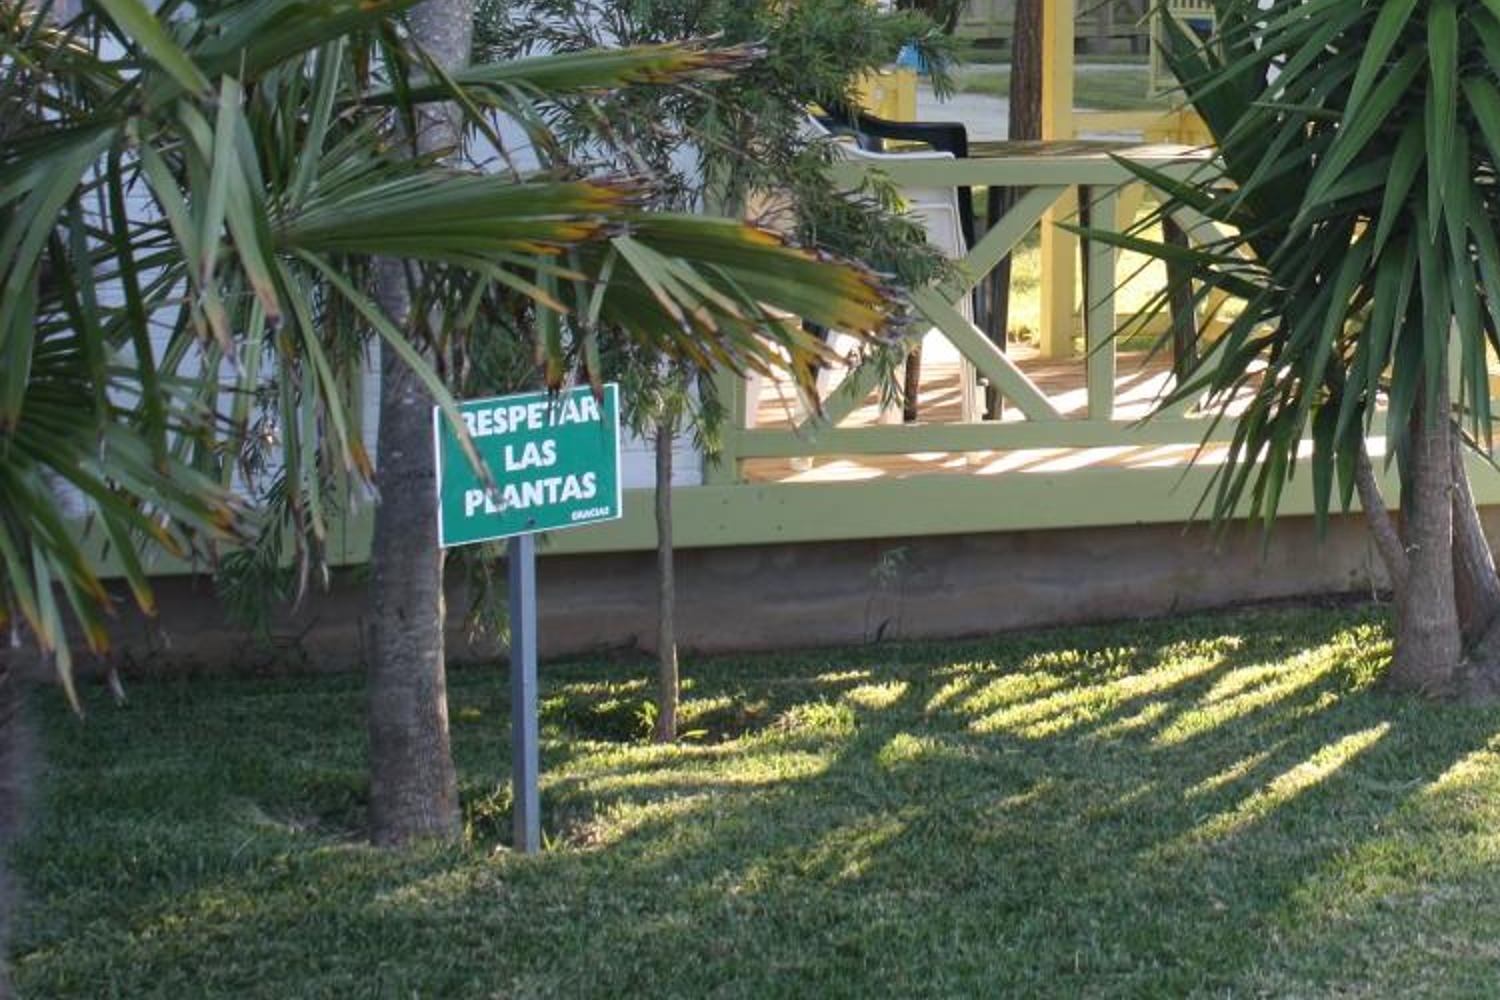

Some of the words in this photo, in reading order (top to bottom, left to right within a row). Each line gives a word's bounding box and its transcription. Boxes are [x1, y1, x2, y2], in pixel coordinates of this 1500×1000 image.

[460, 396, 600, 438] RESPETAR
[505, 439, 557, 472] LAS
[465, 471, 597, 517] PLANTAS
